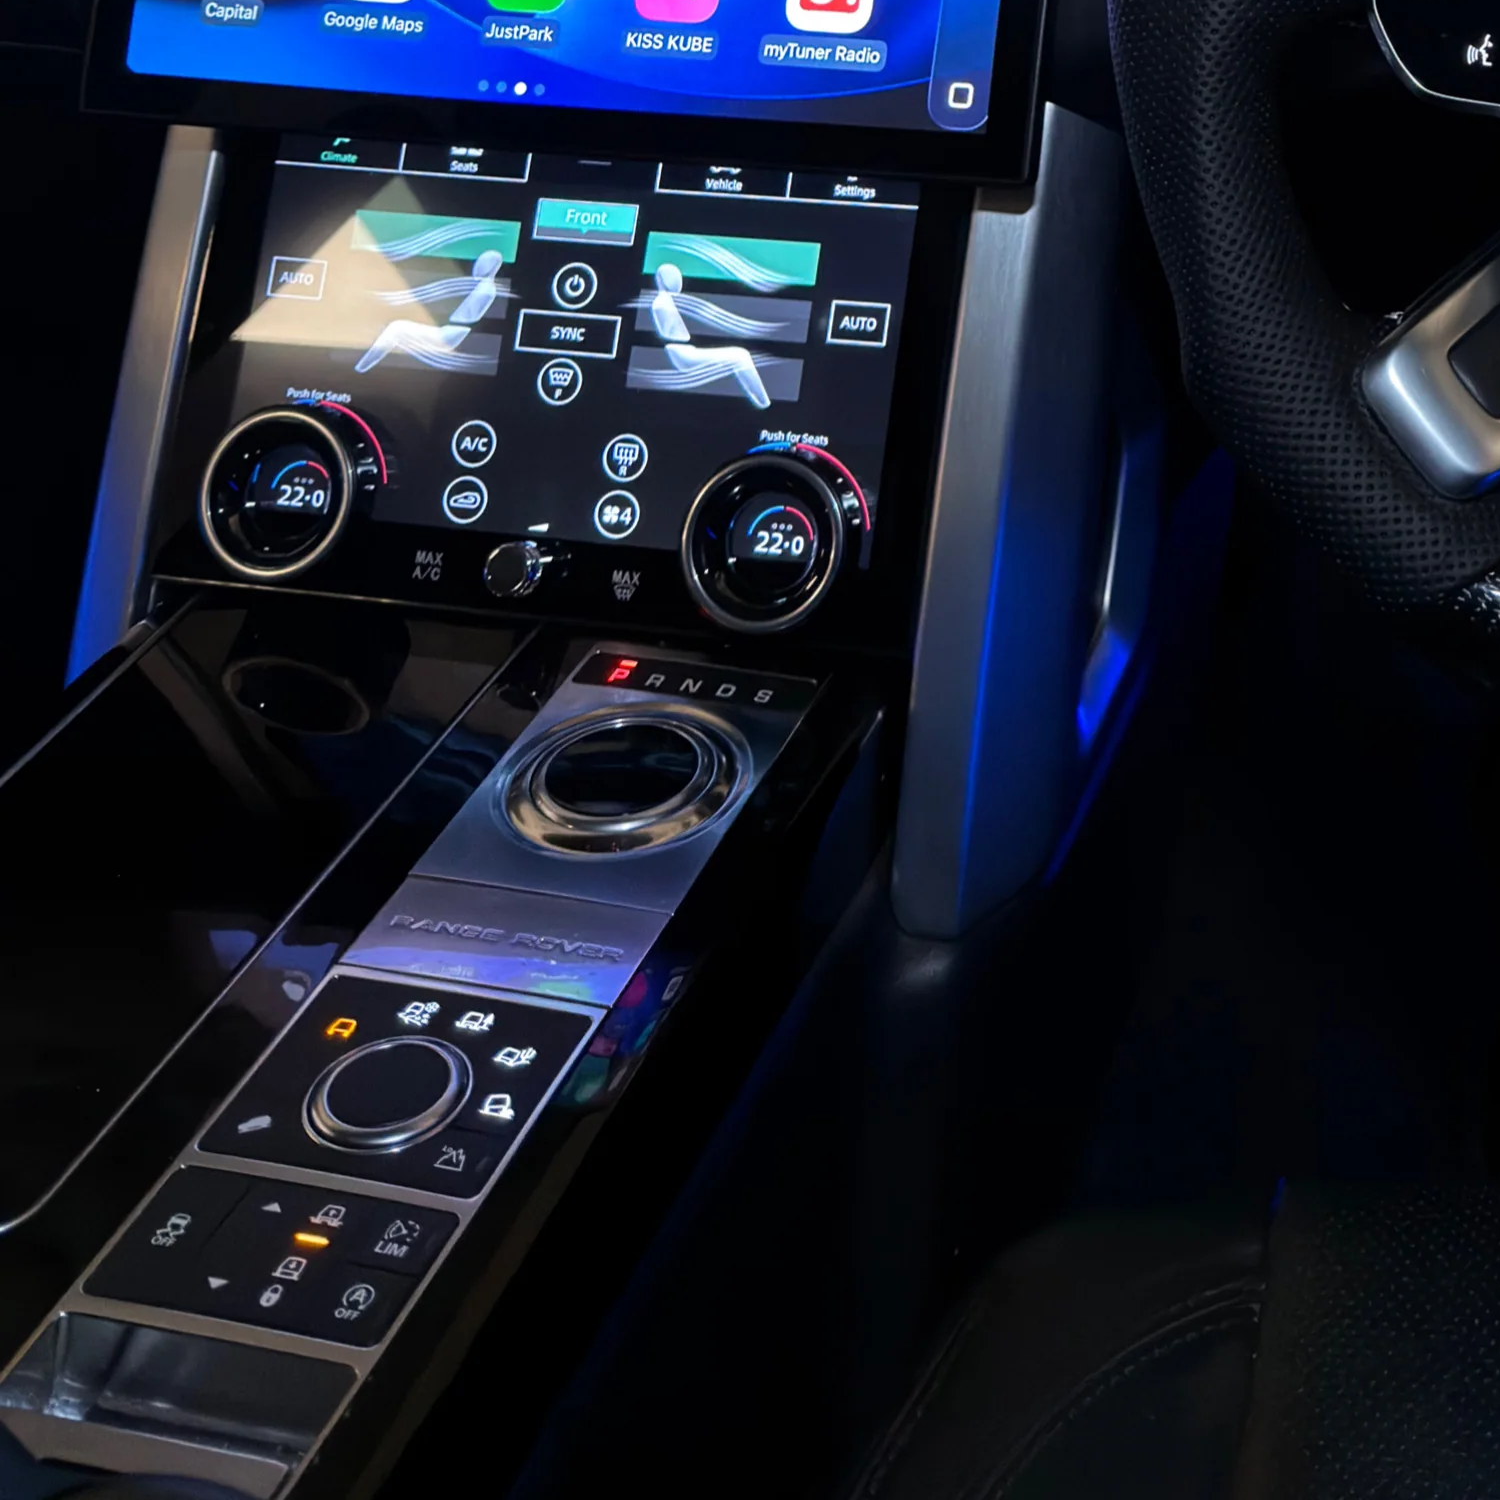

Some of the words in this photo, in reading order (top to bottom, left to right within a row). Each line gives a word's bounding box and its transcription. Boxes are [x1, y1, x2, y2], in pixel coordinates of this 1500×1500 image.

[205, 2, 258, 21] Capital
[324, 12, 377, 31] Google
[381, 16, 423, 33] Maps
[485, 22, 553, 42] JustPark
[626, 32, 664, 50] KISS
[668, 35, 713, 53] KUBE
[764, 44, 831, 63] myTuner
[835, 45, 880, 64] Radio
[320, 150, 358, 163] Climate
[450, 161, 478, 172] Seats
[705, 178, 743, 191] Vehicle
[834, 184, 876, 199] Settings
[565, 208, 608, 226] Front
[280, 271, 314, 287] AUTO
[841, 315, 877, 333] AUTO
[550, 326, 586, 341] SYNC
[286, 387, 310, 398] Push
[311, 389, 325, 400] for
[325, 391, 351, 403] Seats
[460, 436, 488, 452] A/C
[760, 430, 784, 441] Push
[787, 431, 801, 443] for
[801, 433, 828, 446] Seats
[620, 507, 632, 525] 4
[415, 551, 443, 565] MAX
[412, 567, 441, 580] A/C
[612, 570, 640, 585] MAX
[607, 668, 630, 682] P
[645, 673, 665, 687] R
[680, 678, 702, 693] N
[716, 684, 736, 697] D
[754, 690, 773, 703] S
[390, 915, 504, 941] RANGE
[510, 933, 624, 961] ROVER
[151, 1236, 177, 1246] OFF
[374, 1241, 409, 1257] LIM
[334, 1308, 360, 1320] OFF
